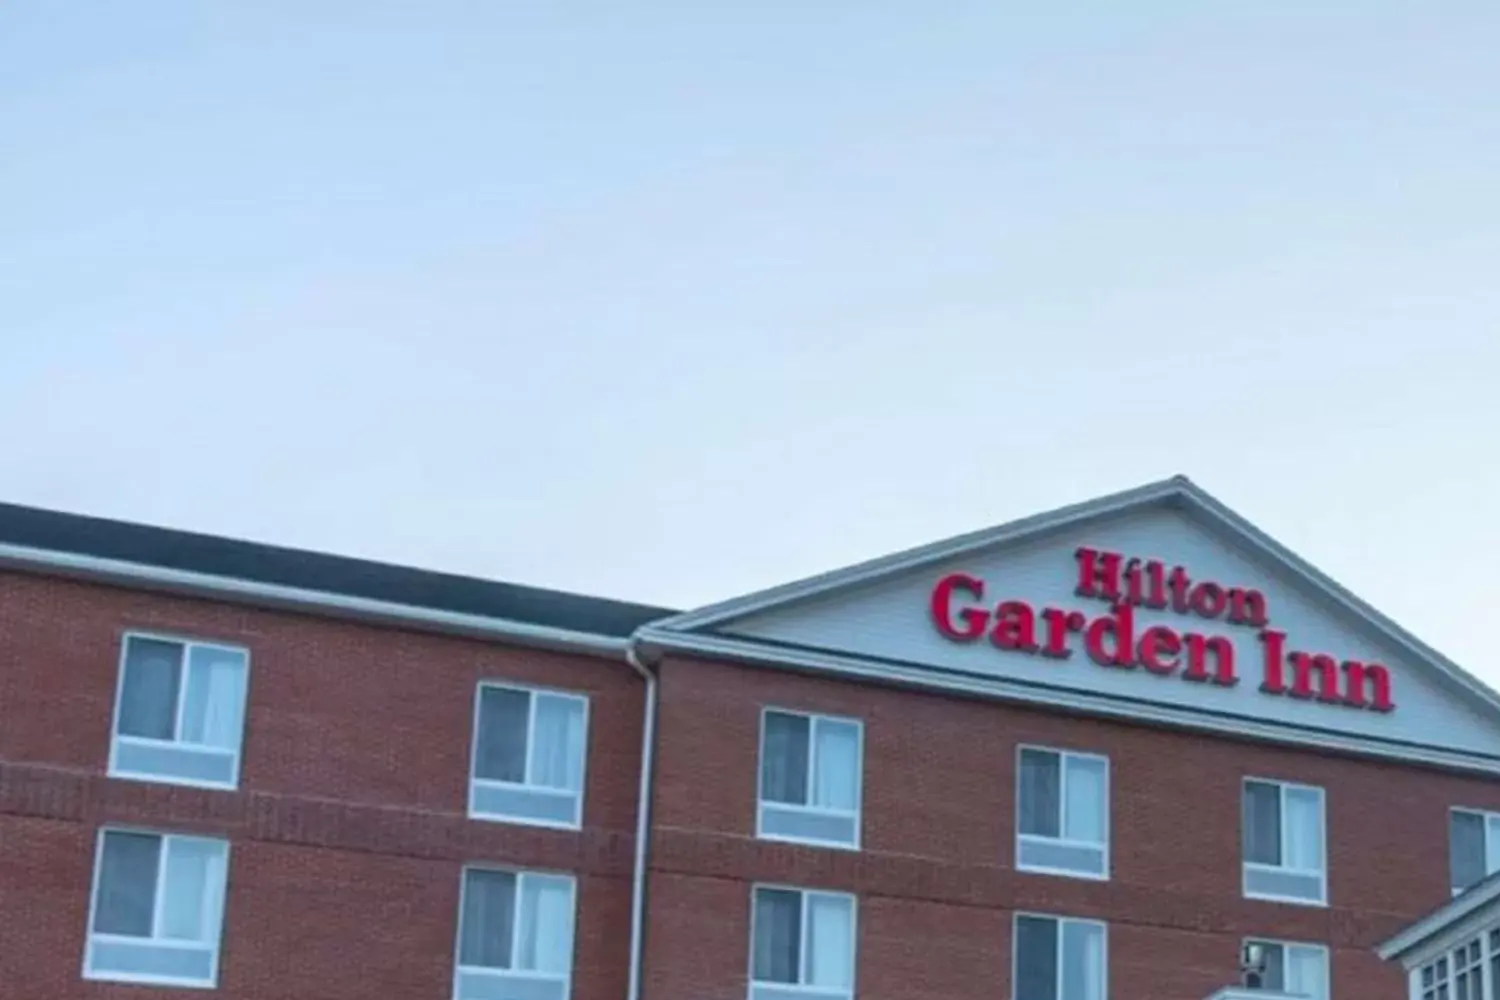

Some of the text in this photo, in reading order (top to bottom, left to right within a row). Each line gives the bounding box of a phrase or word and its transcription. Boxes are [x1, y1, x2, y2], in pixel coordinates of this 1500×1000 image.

[1075, 546, 1268, 627] Hilton
[931, 573, 1396, 712] Garden Inn
